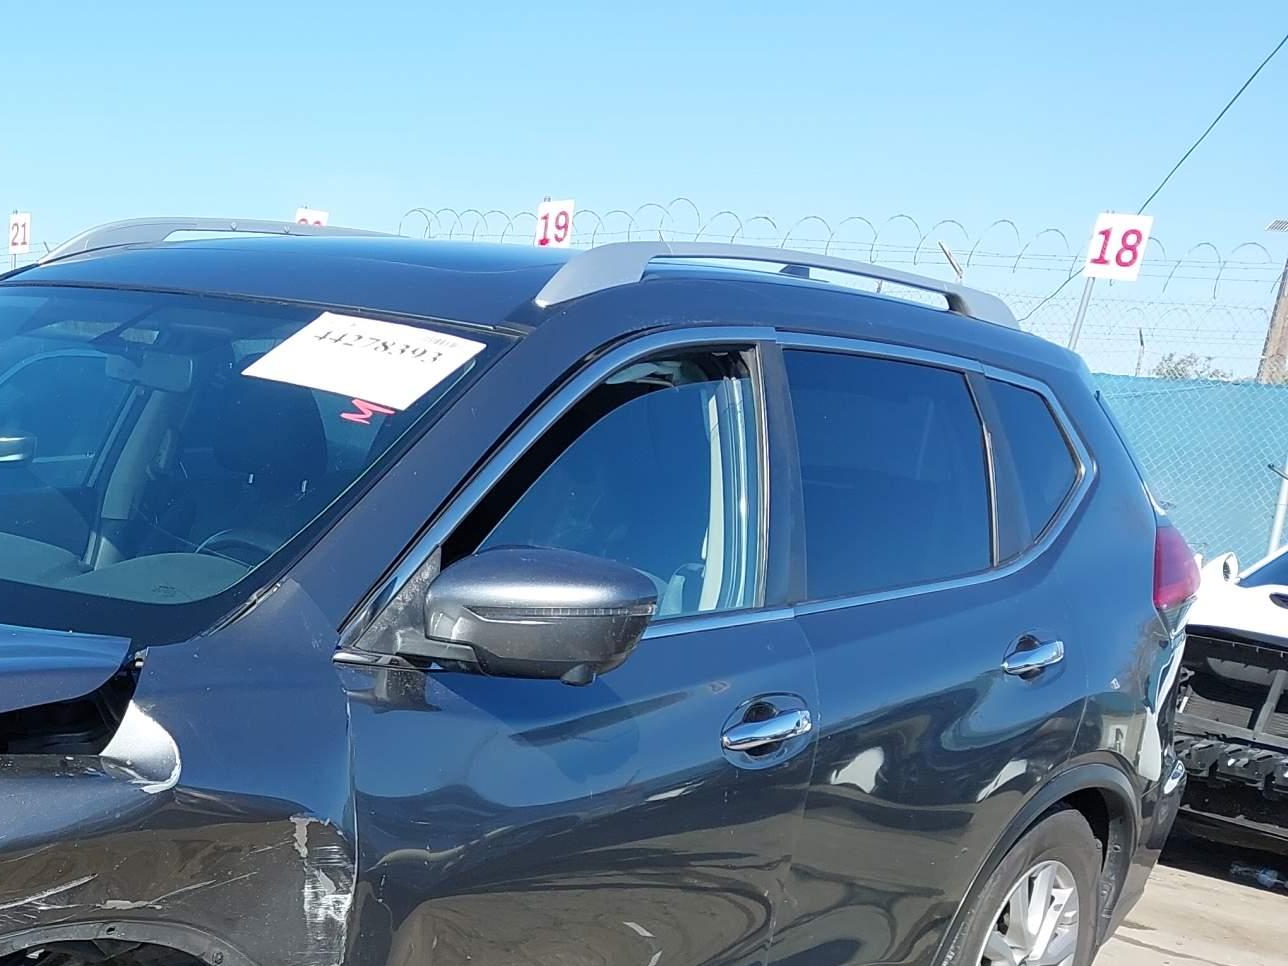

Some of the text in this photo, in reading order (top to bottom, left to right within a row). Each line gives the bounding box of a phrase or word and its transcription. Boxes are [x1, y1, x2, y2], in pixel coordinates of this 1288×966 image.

[11, 222, 27, 246] 21
[538, 210, 569, 246] 19
[1090, 227, 1142, 267] 18
[314, 330, 442, 363] 44278393
